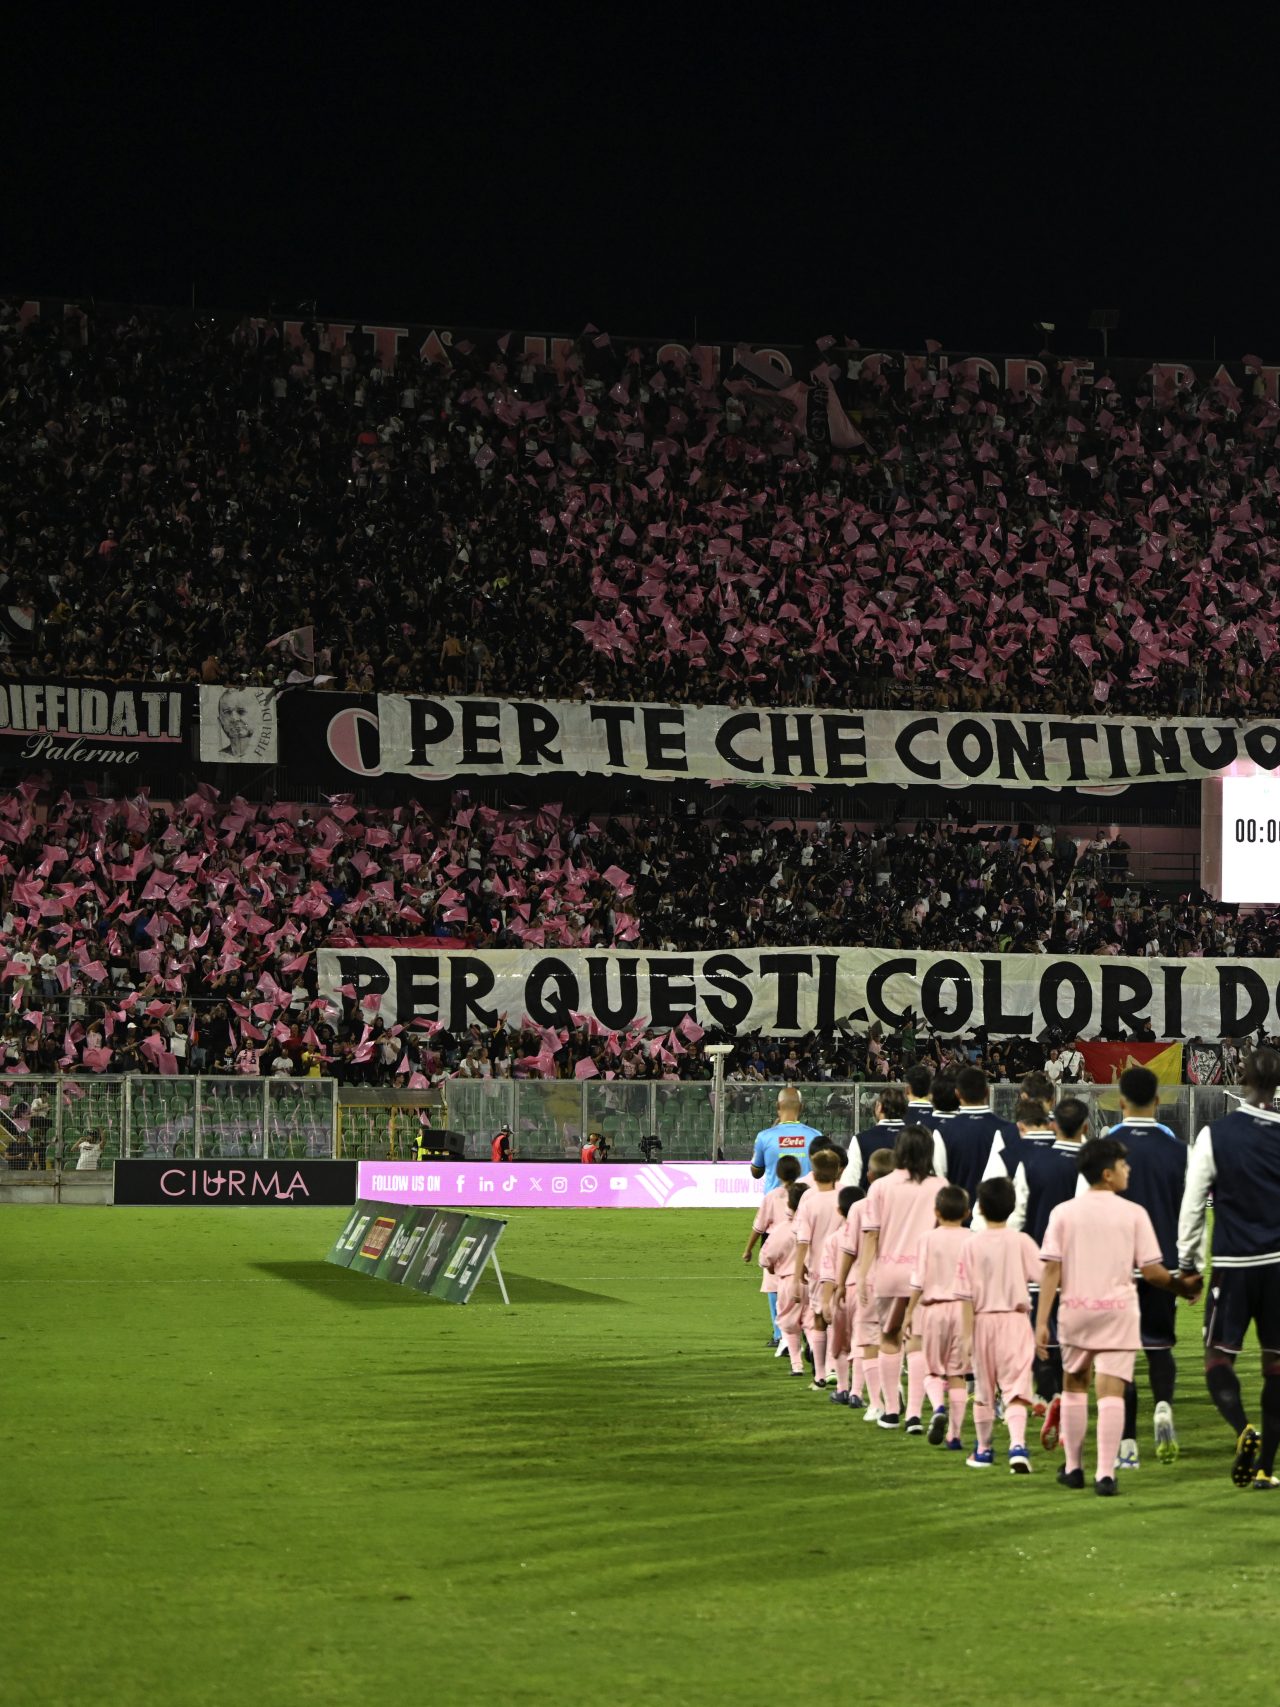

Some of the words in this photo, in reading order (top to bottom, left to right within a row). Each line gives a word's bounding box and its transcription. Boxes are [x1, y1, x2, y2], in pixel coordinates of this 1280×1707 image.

[21, 732, 141, 765] Palermo
[409, 699, 562, 767] PER
[590, 705, 688, 773] TE
[714, 712, 868, 779] CHE
[336, 954, 500, 1032] PER
[523, 953, 840, 1037] QUESTI
[865, 957, 1188, 1038] COLORI
[160, 1168, 310, 1199] CIURMA
[372, 1174, 409, 1192] FOLLOW
[412, 1175, 425, 1192] US
[428, 1175, 441, 1192] ON
[714, 1178, 750, 1194] FOLLOW
